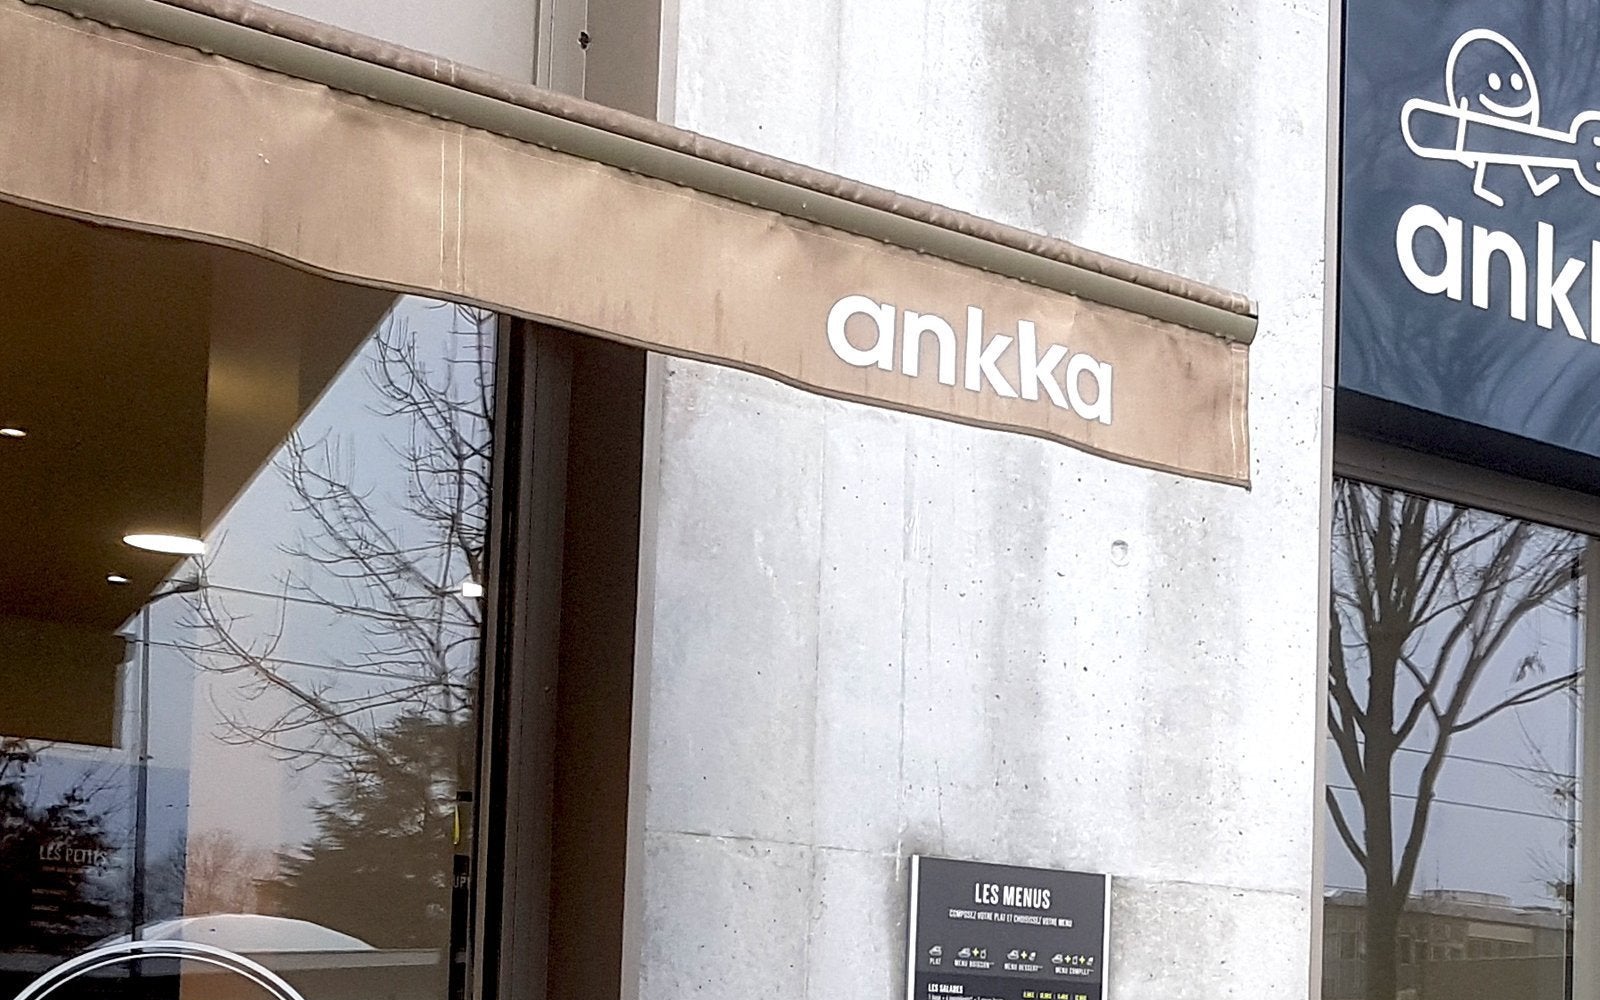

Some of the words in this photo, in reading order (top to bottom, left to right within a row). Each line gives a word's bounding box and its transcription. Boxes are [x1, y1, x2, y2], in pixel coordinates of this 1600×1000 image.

[827, 295, 1113, 425] ankka
[974, 882, 999, 905] LES
[1002, 885, 1051, 909] MENUS
